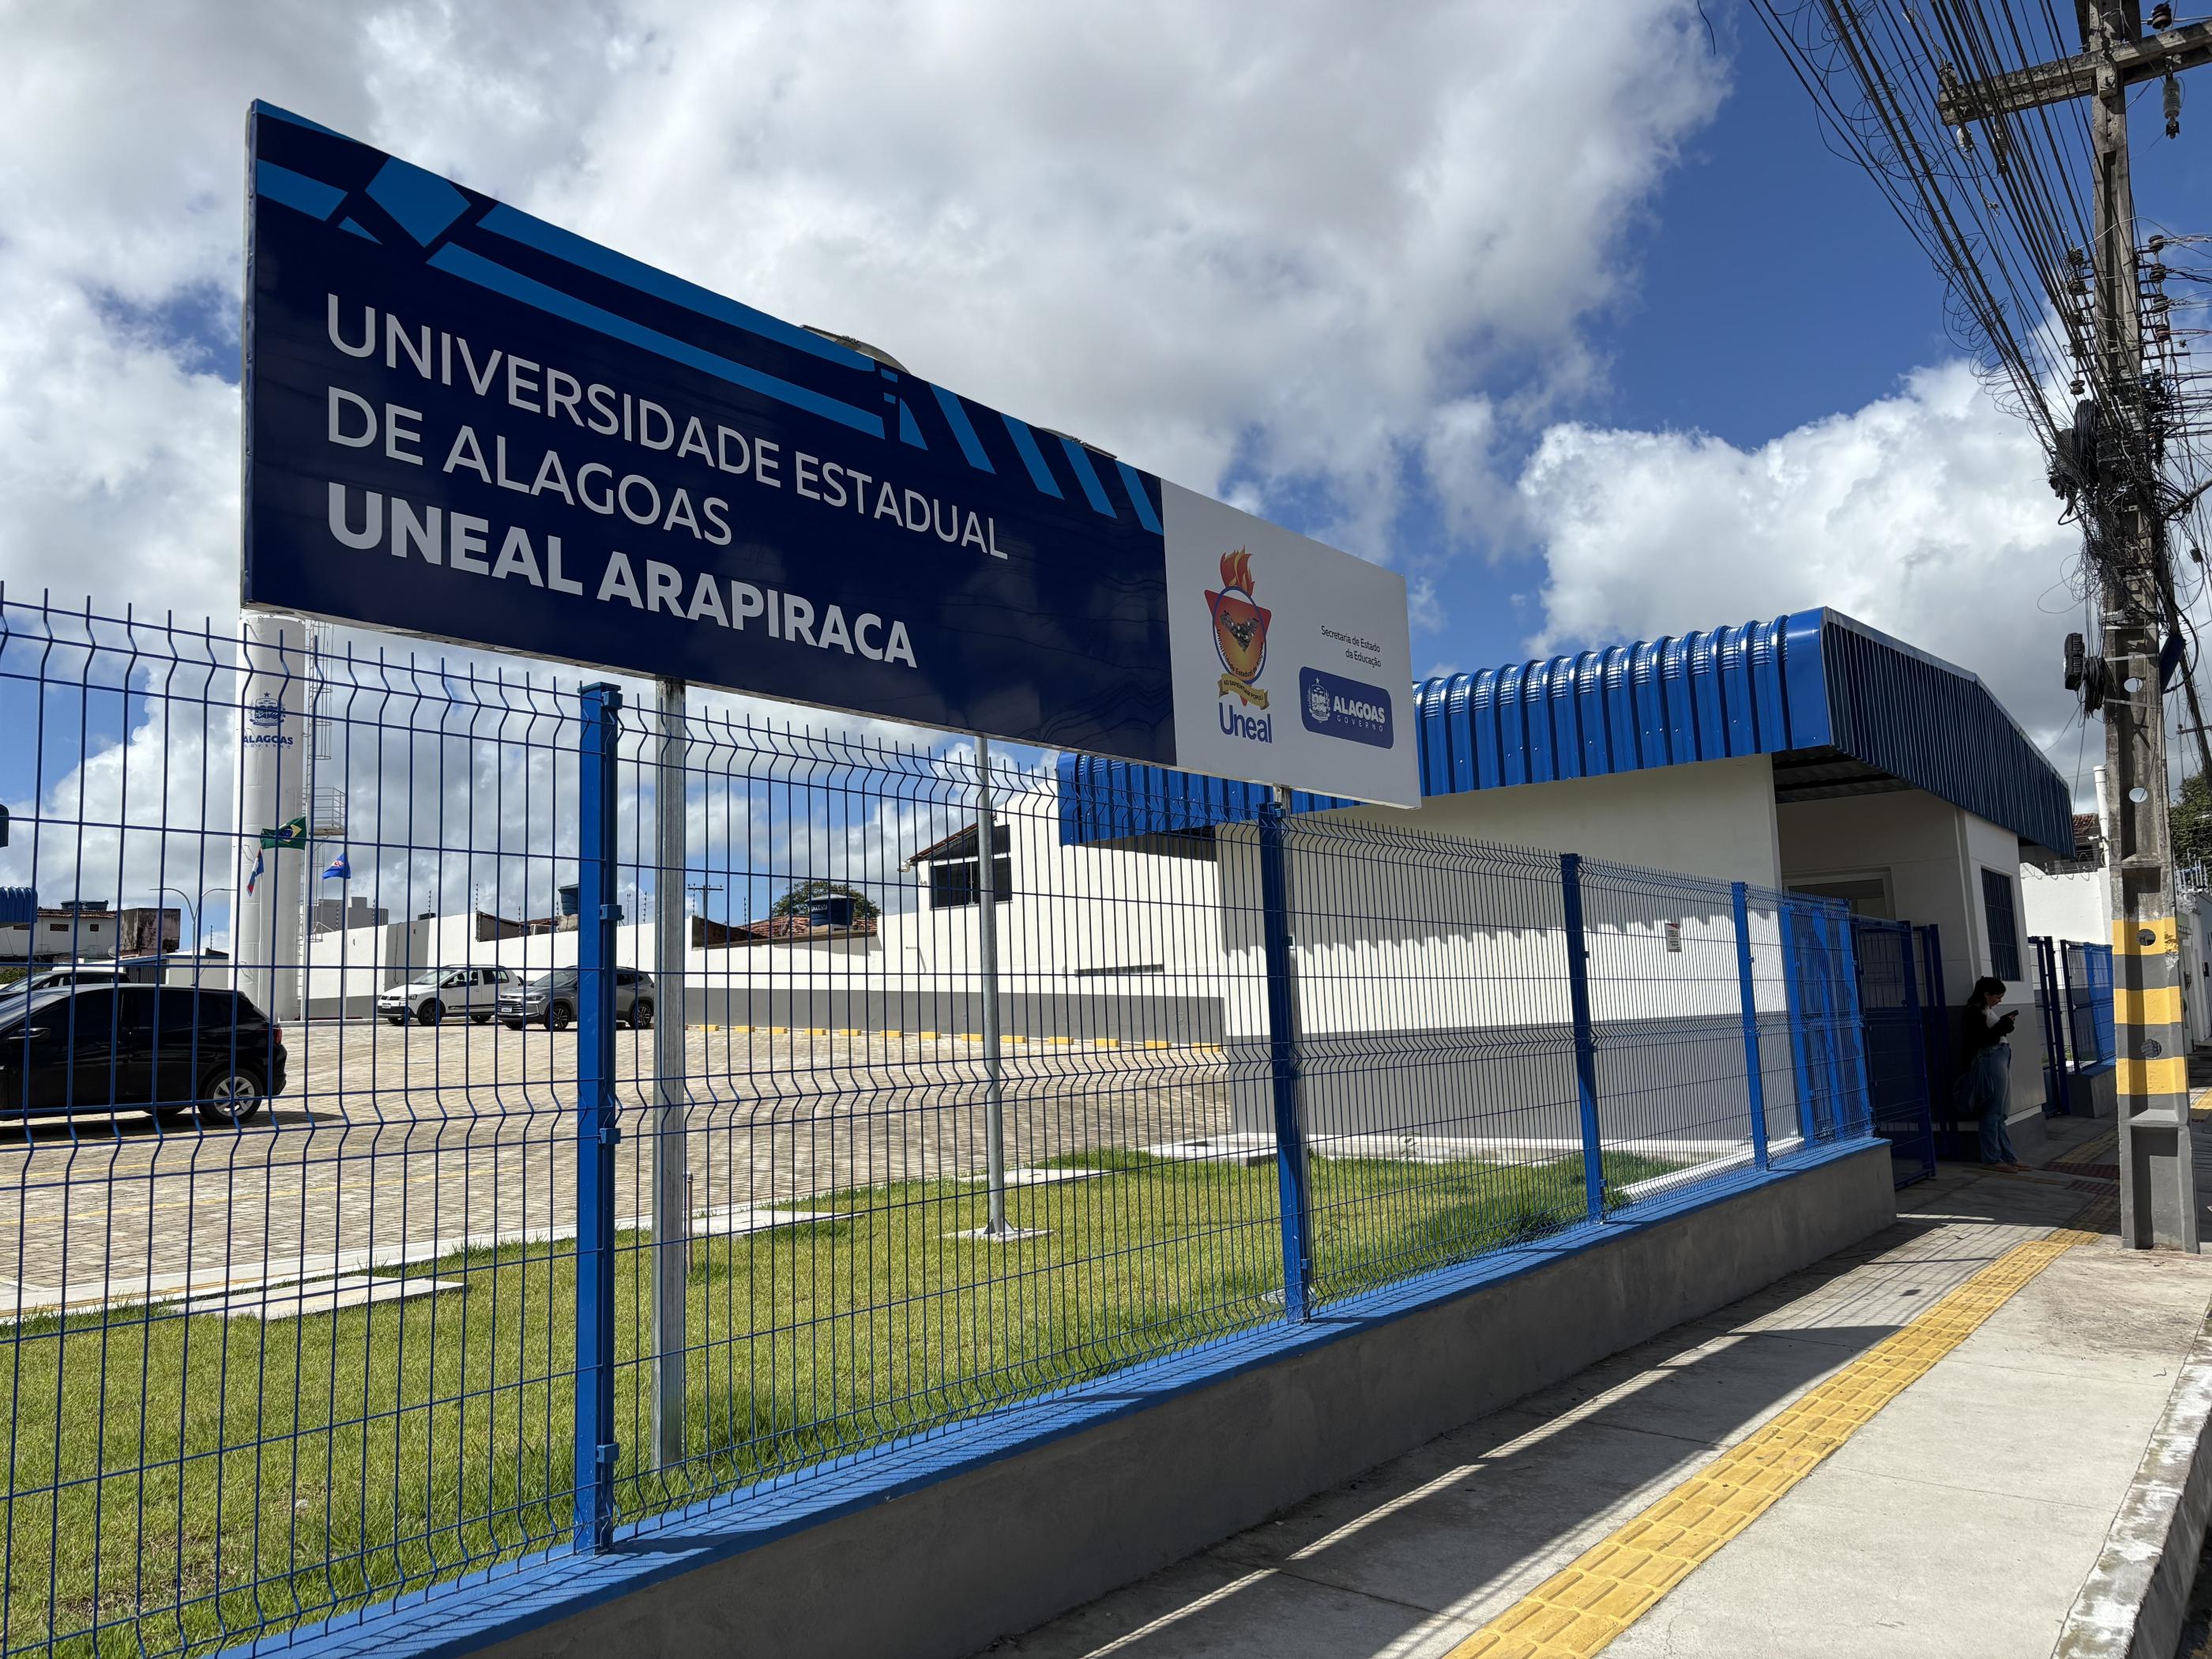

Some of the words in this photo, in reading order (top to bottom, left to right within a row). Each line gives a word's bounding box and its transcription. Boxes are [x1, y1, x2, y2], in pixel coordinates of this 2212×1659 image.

[327, 293, 781, 488] UNIVERSIDADE
[795, 450, 1008, 560] ESTADUAL
[327, 386, 423, 466] DE
[442, 424, 732, 546] ALAGOAS
[327, 481, 583, 596] UNEAL
[596, 551, 918, 668] ARAPIRACA
[1321, 625, 1352, 644] Secretaria
[1352, 635, 1360, 646] de
[1360, 638, 1381, 653] Estado
[1345, 648, 1353, 659] da
[1354, 650, 1382, 668] Educação
[1219, 702, 1273, 743] Uneal
[1333, 695, 1386, 724] ALAGOAS
[1337, 715, 1383, 732] GOVERNO
[243, 735, 293, 745] ALAGOAS
